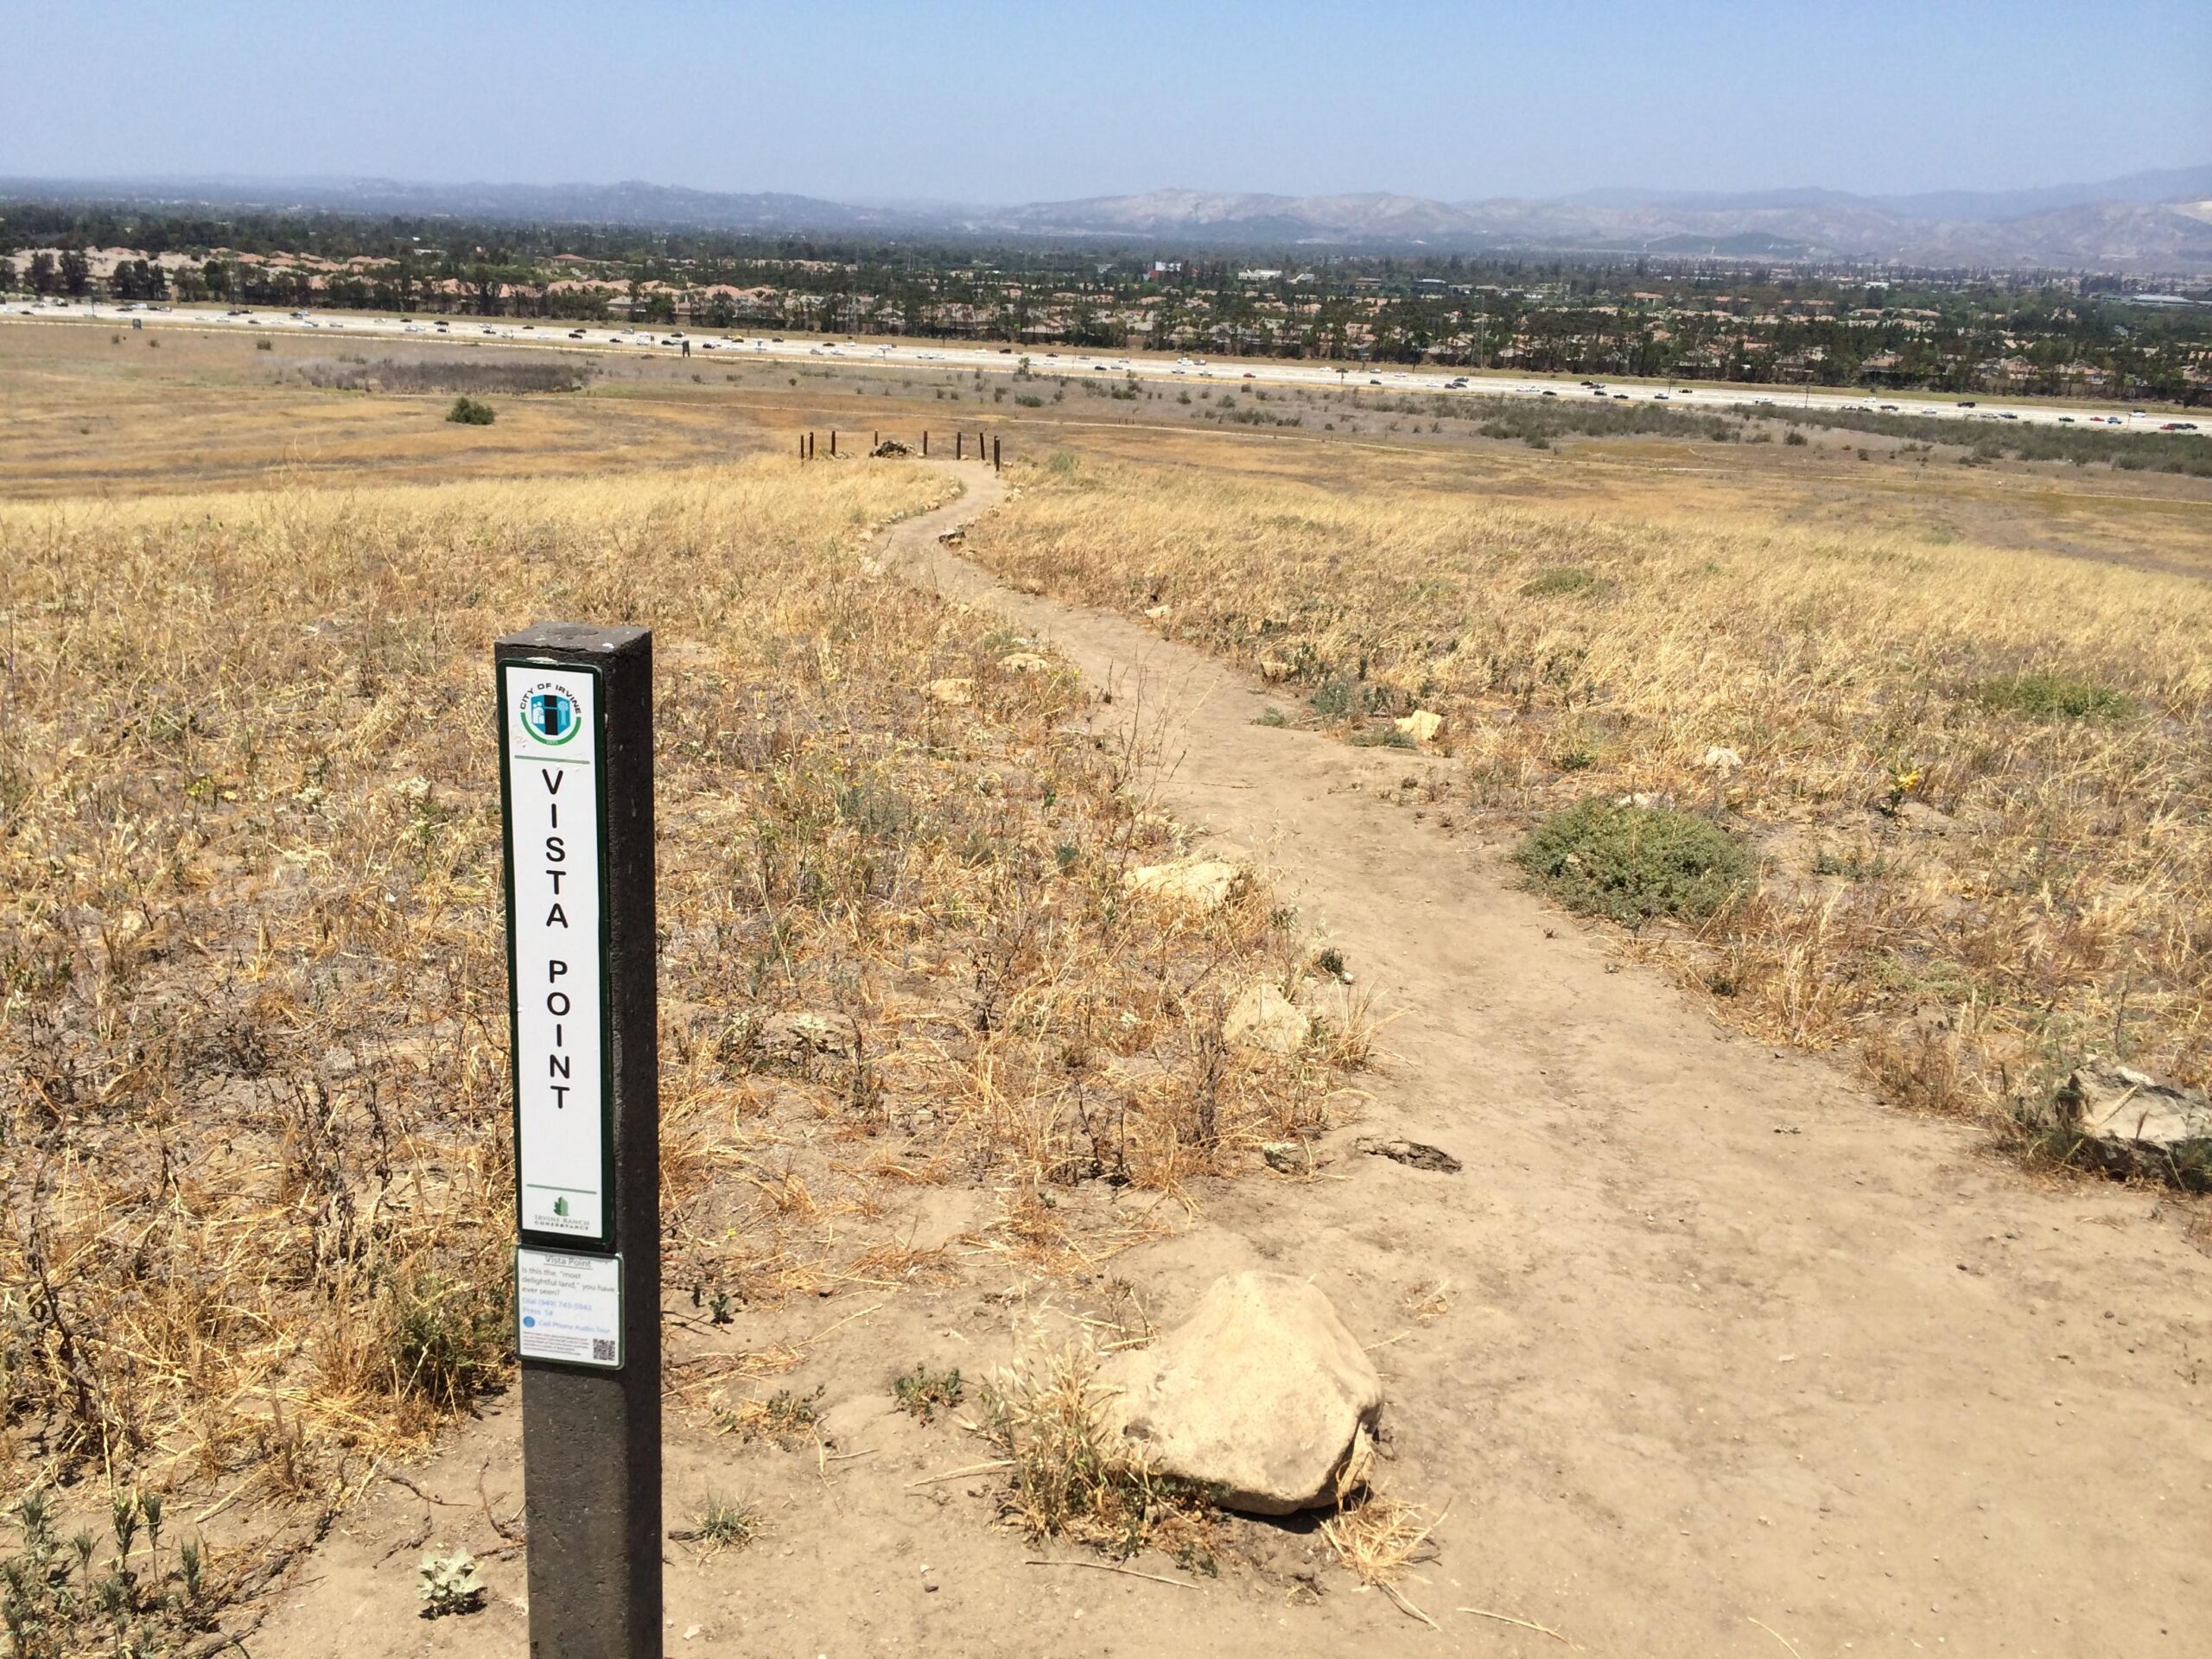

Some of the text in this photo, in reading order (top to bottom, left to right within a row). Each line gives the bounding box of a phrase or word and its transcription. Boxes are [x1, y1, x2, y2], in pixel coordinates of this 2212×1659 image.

[519, 688, 534, 710] CITY
[555, 684, 582, 715] IRVINE
[542, 768, 569, 928] VISTA
[547, 959, 570, 1109] POINT
[545, 1255, 591, 1268] Vista Point
[522, 1276, 556, 1287] delightful
